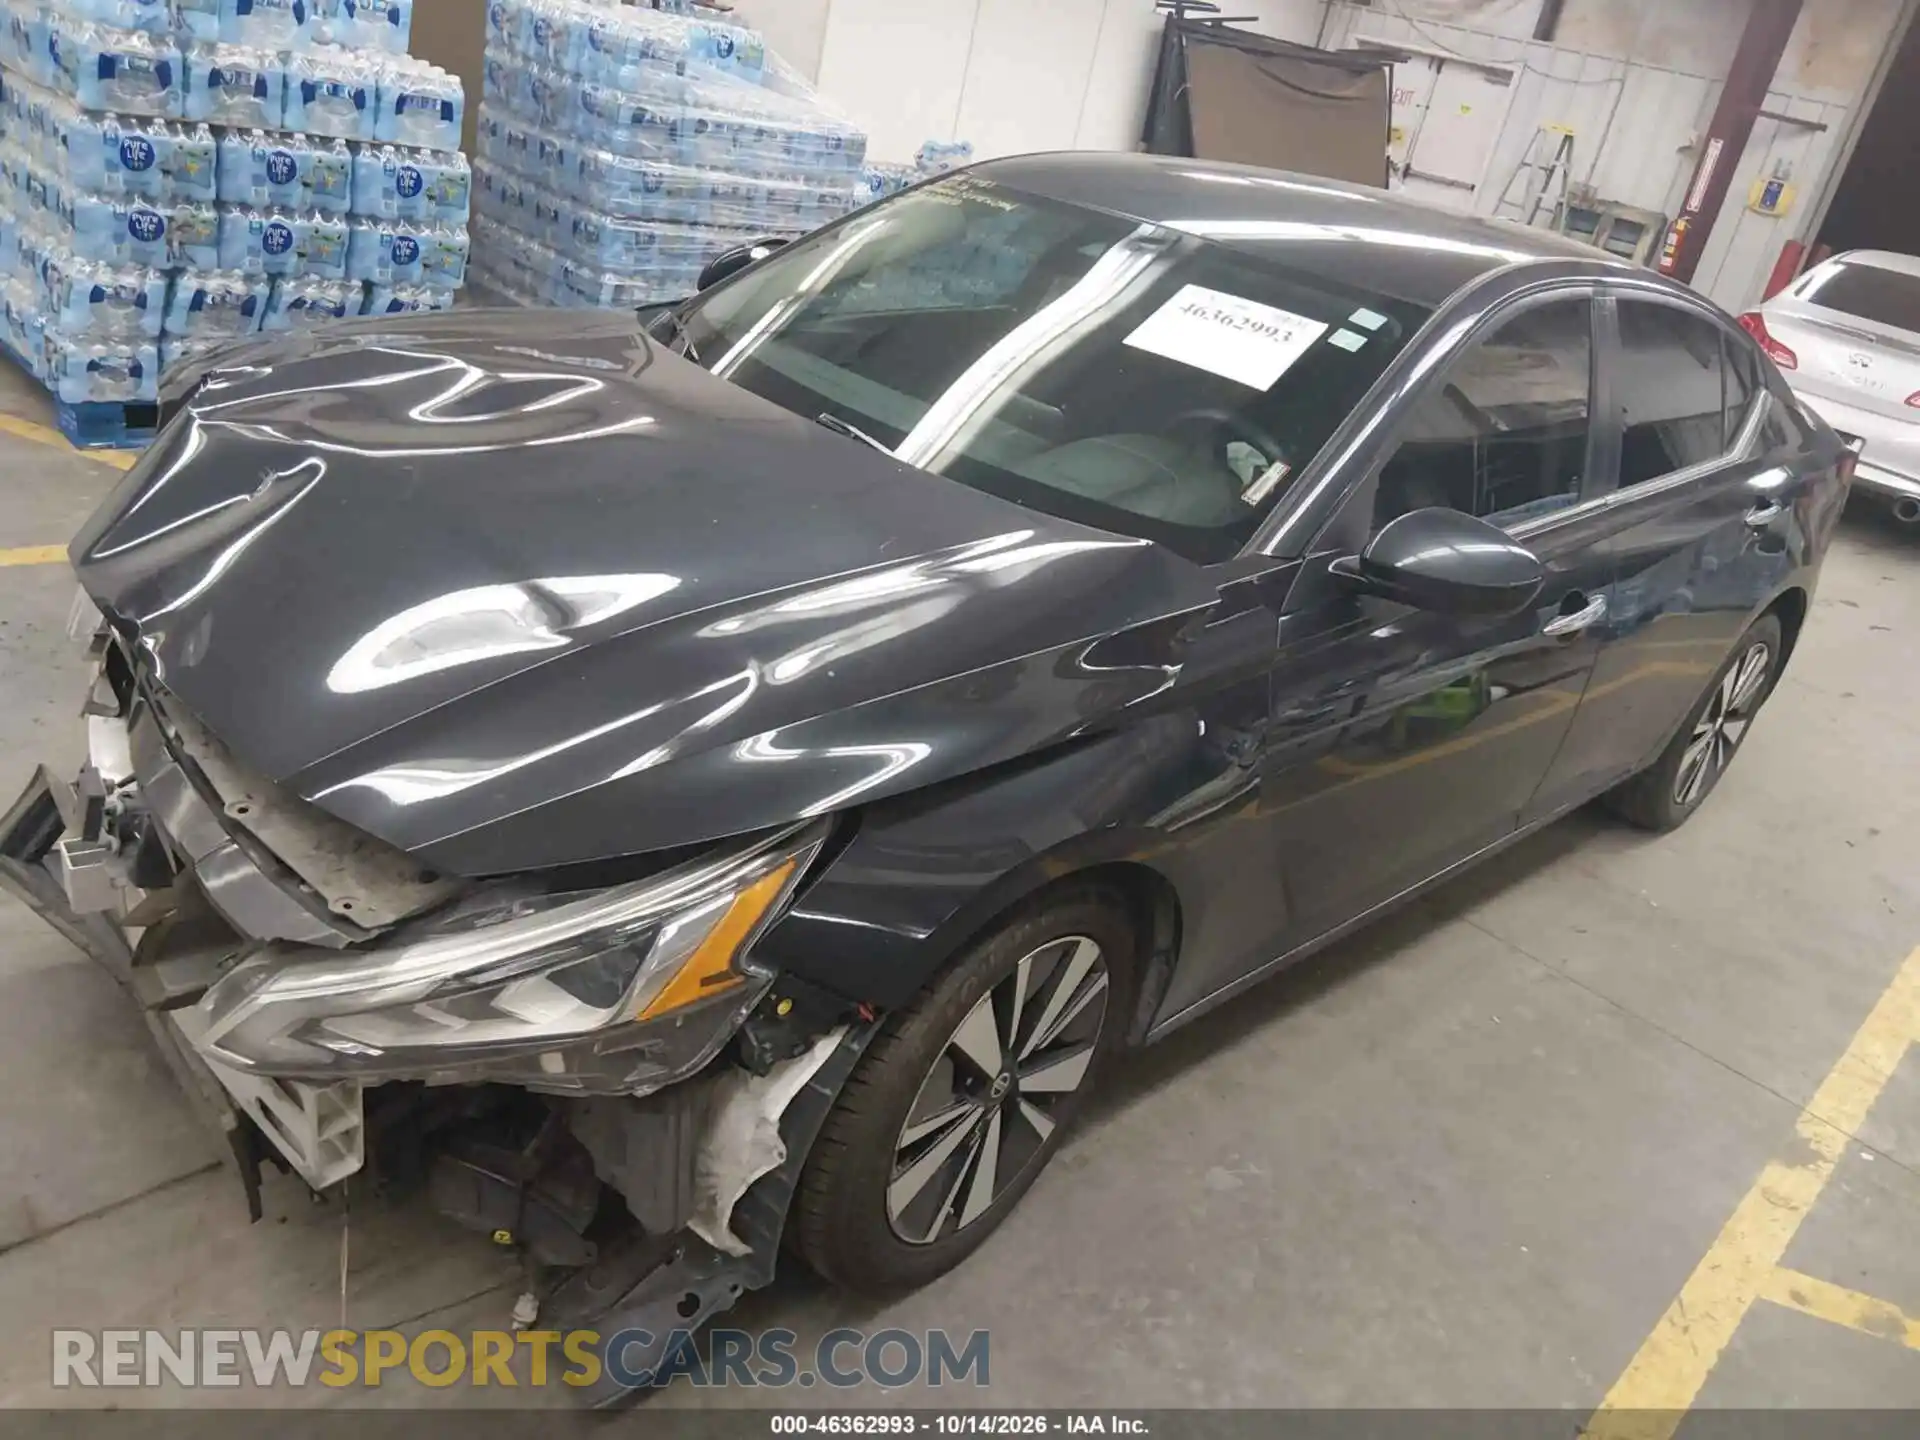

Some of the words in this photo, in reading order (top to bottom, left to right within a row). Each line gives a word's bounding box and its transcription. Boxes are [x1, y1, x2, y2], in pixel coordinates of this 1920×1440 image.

[1392, 87, 1415, 106] EXIT
[124, 139, 149, 150] Pure
[127, 149, 147, 162] Life
[270, 156, 292, 168] Pure
[271, 165, 289, 178] Life
[399, 171, 418, 181] Pure
[400, 179, 417, 191] Life
[132, 214, 159, 225] Pure
[136, 222, 157, 234] Life
[267, 227, 288, 239] Pure
[268, 235, 286, 247] Life
[396, 239, 415, 250] Pure
[396, 247, 413, 259] Life
[1180, 303, 1293, 342] 46362993
